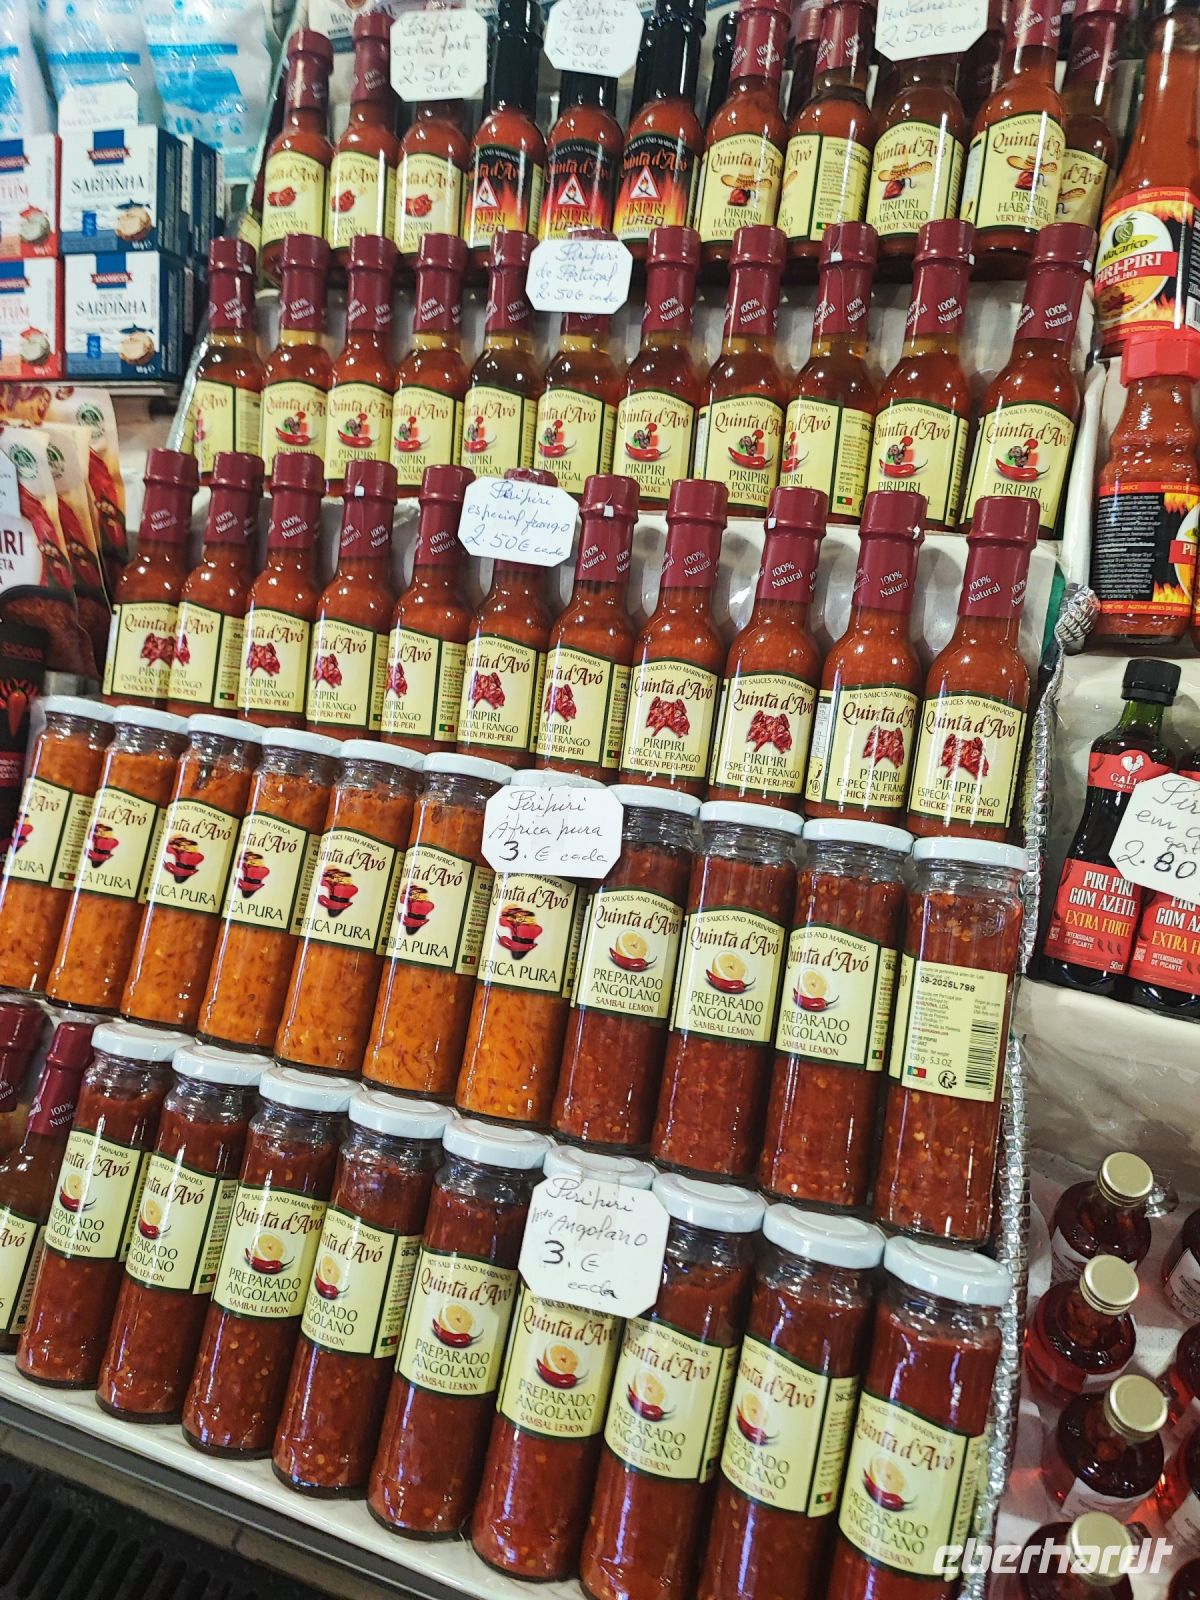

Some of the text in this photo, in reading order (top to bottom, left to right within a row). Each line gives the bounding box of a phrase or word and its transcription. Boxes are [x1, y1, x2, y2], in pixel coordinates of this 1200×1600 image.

[399, 62, 451, 85] 2.50
[711, 150, 753, 174] Quinta
[72, 175, 145, 195] SARDINHA
[622, 214, 665, 227] TURBO
[723, 207, 762, 223] PIRIPIRI
[995, 213, 1015, 223] VERY
[557, 262, 618, 288] Portugal
[76, 298, 148, 318] SARDINHA
[659, 296, 679, 311] 100%
[660, 304, 686, 322] Natural
[740, 298, 760, 313] 100%
[846, 298, 865, 312] 100%
[937, 296, 958, 311] 100%
[1044, 303, 1068, 317] 100%
[740, 306, 768, 325] Natural
[938, 305, 964, 324] Natural
[1044, 311, 1073, 329] Natural
[655, 411, 690, 431] d'Avó
[714, 411, 759, 435] Quinta
[910, 421, 950, 441] d'Avó
[625, 463, 666, 476] PIRIPIRI
[729, 469, 770, 485] PIRIPIRI
[993, 481, 1041, 499] PIRIPIRI
[280, 514, 302, 530] 100%
[468, 504, 570, 536] especial frango
[281, 521, 309, 540] Natural
[429, 529, 450, 545] 100%
[430, 536, 457, 557] Natural
[682, 550, 706, 566] 100%
[684, 557, 712, 578] Natural
[772, 561, 796, 577] 100%
[880, 570, 903, 586] 100%
[772, 569, 804, 590] Natural
[880, 578, 909, 599] Natural
[968, 575, 992, 592] 100%
[968, 583, 1001, 604] Natural
[267, 627, 305, 645] d'Avó
[329, 633, 367, 654] d'Avó
[397, 643, 433, 662] d'Avó
[490, 653, 530, 673] d'Avó
[563, 664, 604, 685] d'Avó
[634, 676, 713, 701] Quinta d'Avó
[732, 688, 777, 711] Quinta
[482, 723, 519, 734] FRANGO
[925, 710, 1016, 738] Quinta d'Avó
[554, 735, 591, 747] FRANGO
[643, 737, 685, 752] PIRIPIRI
[665, 752, 701, 763] FRANGO
[743, 752, 787, 767] PIRIPIRI
[724, 761, 800, 780] ESPECIAL FRANGO
[727, 771, 761, 786] CHICKEN
[935, 778, 983, 794] PIRIPIRI
[508, 787, 587, 817] Piripiri
[959, 795, 1000, 808] FRANGO
[111, 805, 147, 827] d'Avó
[1136, 810, 1178, 829] em
[191, 820, 232, 841] d'Avó
[488, 813, 604, 841] África pura
[260, 834, 298, 854] d'Avó
[360, 839, 380, 853] AFRICA
[344, 851, 387, 871] d'Avó
[437, 854, 457, 867] AFRICA
[534, 846, 551, 861] €
[560, 848, 608, 863] cada
[1116, 840, 1197, 879] 2.80
[96, 873, 133, 891] PURA
[422, 868, 463, 887] d'Avó
[1083, 871, 1134, 898] PIRI-PIRI
[183, 891, 217, 907] PURA
[527, 888, 569, 909] d'Avó
[611, 894, 635, 903] SAUCES
[1099, 894, 1136, 918] AZEITE
[247, 905, 283, 921] PURA
[595, 904, 680, 935] Quinta d'Avó
[333, 924, 371, 941] PURA
[1065, 910, 1130, 938] EXTRA FORTE
[690, 926, 779, 956] Quinta d'Avó
[829, 935, 868, 952] MARINADES
[1066, 930, 1095, 943] INTENSIDADE
[1072, 939, 1094, 950] PICANTE
[1152, 931, 1187, 952] EXTRA
[411, 941, 450, 959] PURA
[822, 951, 869, 973] d'Avó
[1110, 960, 1124, 971] 50ml
[1159, 961, 1183, 972] PICANTE
[519, 966, 557, 984] PURA
[593, 967, 664, 990] PREPARADO
[591, 981, 662, 1003] ANGOLANO
[595, 997, 655, 1014] SAMBAL LEMON
[691, 990, 764, 1014] PREPARADO
[688, 1005, 761, 1026] ANGOLANO
[782, 1010, 850, 1032] PREPARADO
[693, 1019, 755, 1037] SAMBAL LEMON
[780, 1025, 848, 1046] ANGOLANO
[810, 1045, 839, 1056] LEMON
[50, 1102, 73, 1117] 100%
[545, 1178, 635, 1211] Piripiri
[549, 1215, 648, 1246] Angolano
[581, 1253, 600, 1272] €
[228, 1267, 301, 1291] PREPARADO
[420, 1267, 468, 1295] Quinta
[225, 1282, 299, 1303] ANGOLANO
[568, 1280, 620, 1299] cada
[228, 1297, 290, 1315] SAMBAL LEMON
[522, 1305, 571, 1334] Quinta
[415, 1338, 490, 1362] PREPARADO
[412, 1357, 487, 1380] ANGOLANO
[660, 1350, 711, 1382] d'Avó
[449, 1380, 479, 1392] LEMON
[518, 1378, 597, 1407] PREPARADO
[764, 1376, 816, 1408] d'Avó
[515, 1397, 593, 1421] ANGOLANO
[554, 1421, 585, 1434] LEMON
